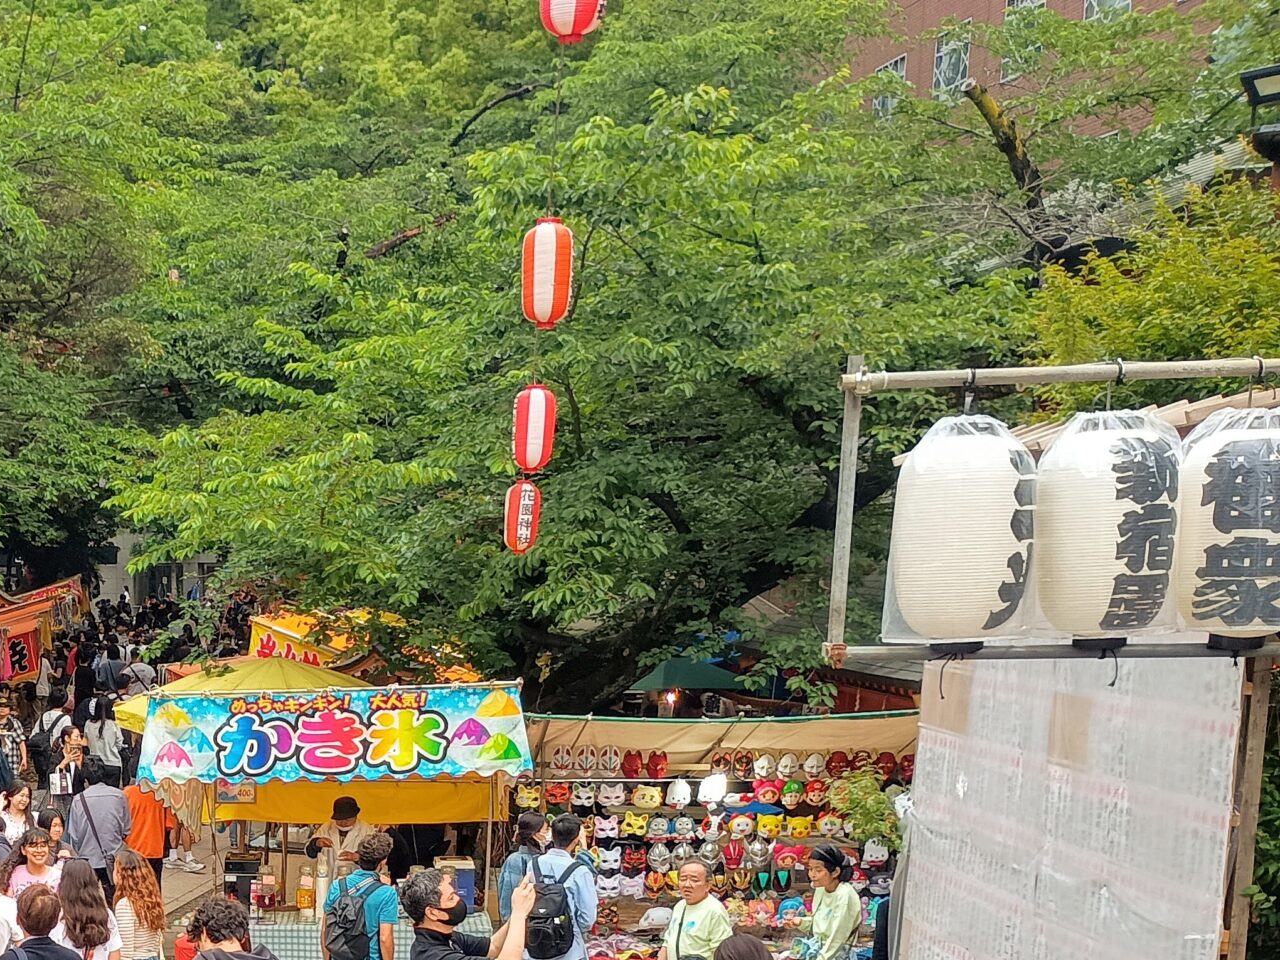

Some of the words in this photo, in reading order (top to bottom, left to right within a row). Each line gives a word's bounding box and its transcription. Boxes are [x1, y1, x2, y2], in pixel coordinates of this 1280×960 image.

[517, 489, 535, 545] 花園神社
[230, 695, 350, 713] めっちゃキンキン!
[370, 691, 428, 710] 大人気!
[218, 708, 444, 772] かき氷
